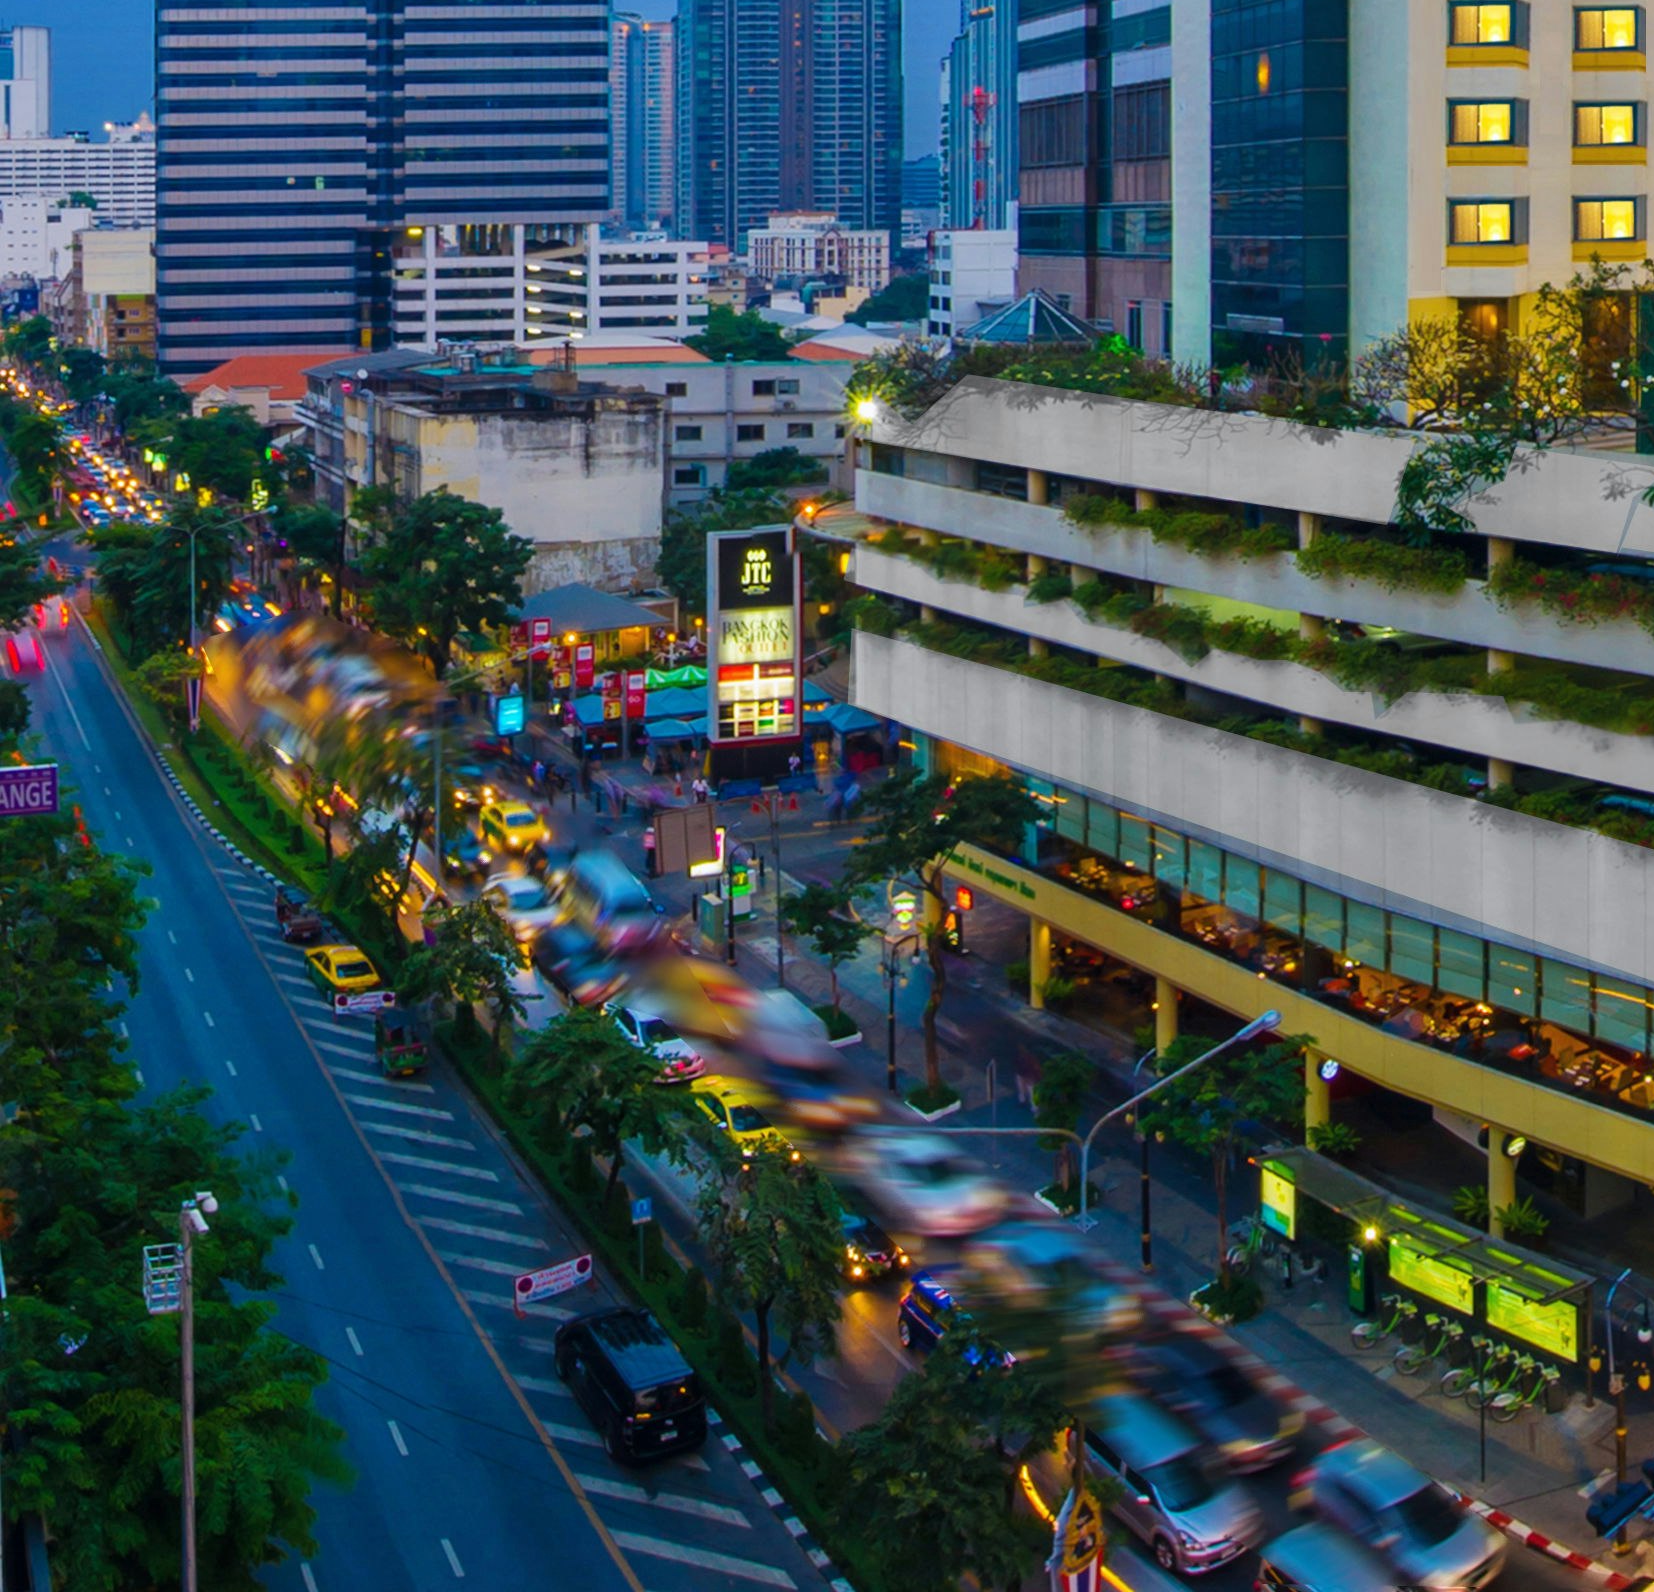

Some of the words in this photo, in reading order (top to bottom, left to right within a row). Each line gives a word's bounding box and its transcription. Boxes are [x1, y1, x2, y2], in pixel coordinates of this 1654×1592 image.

[741, 561, 772, 584] JTC
[722, 617, 789, 636] BANGKOK
[722, 630, 790, 646] FASHION
